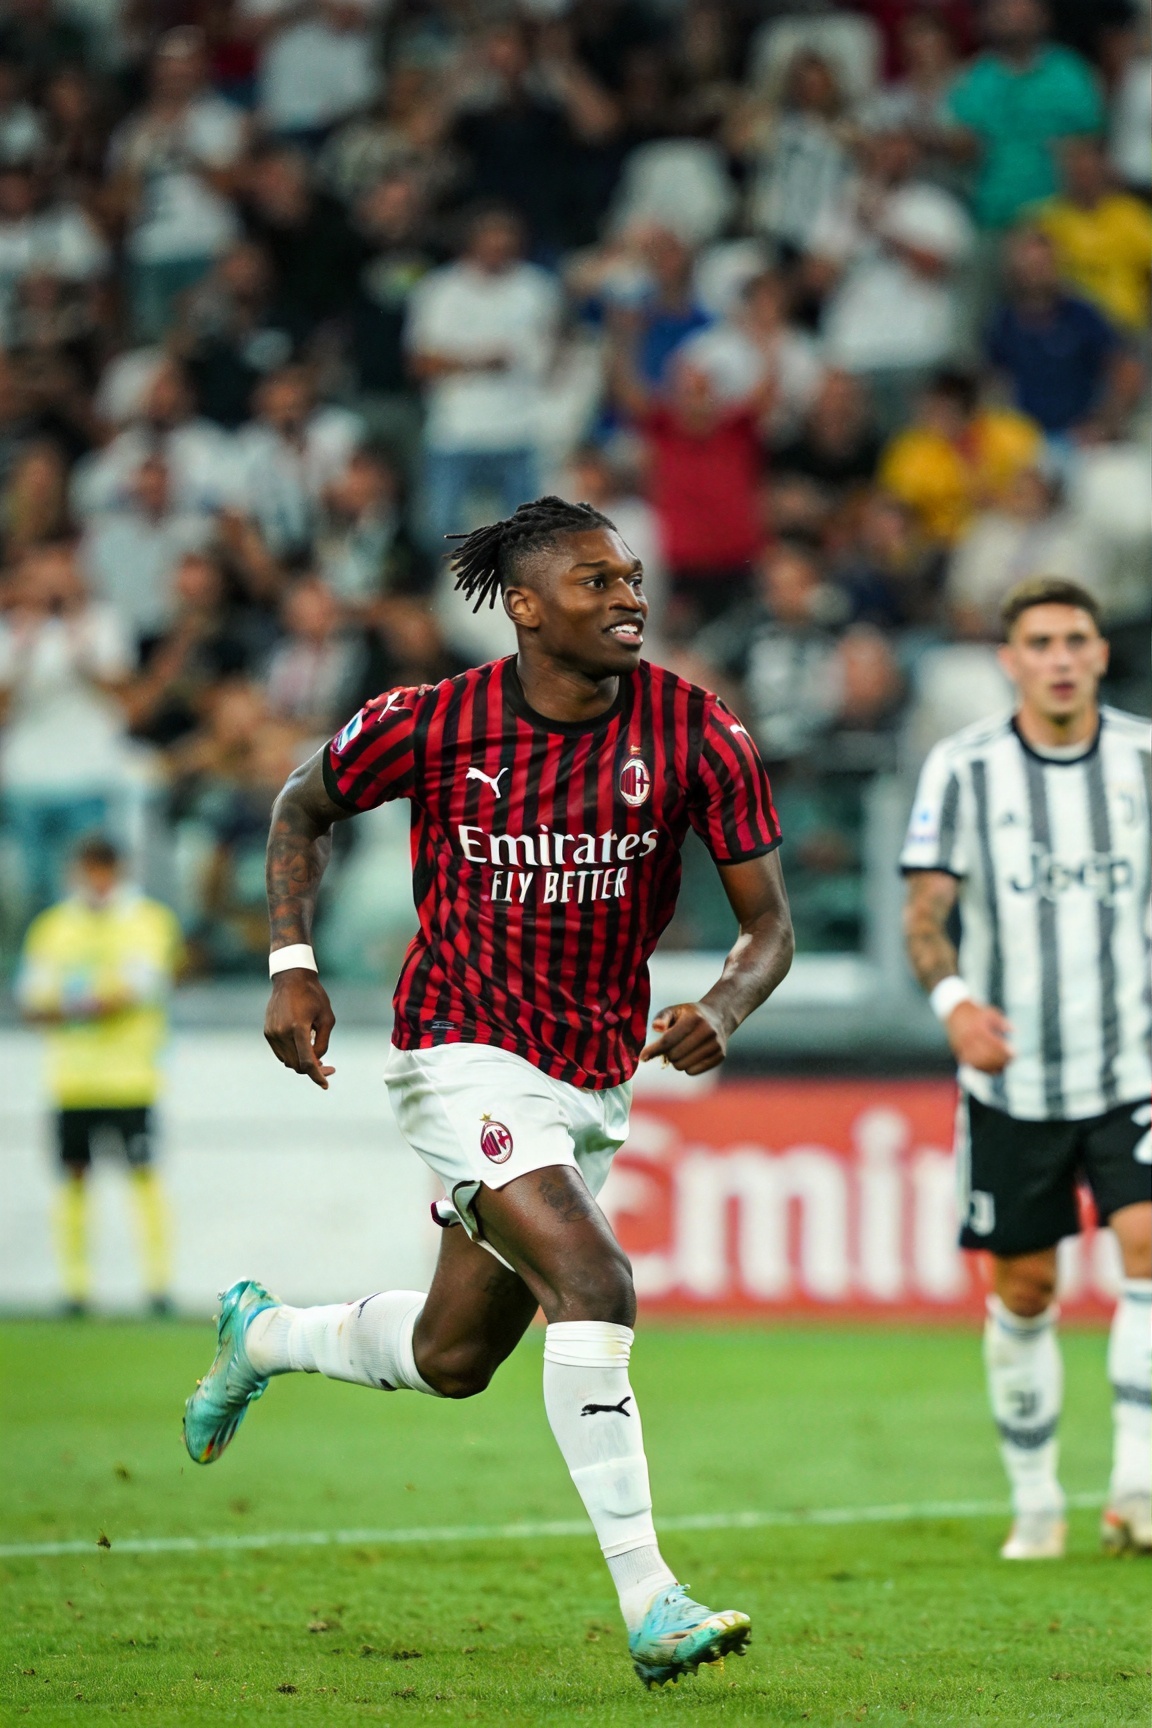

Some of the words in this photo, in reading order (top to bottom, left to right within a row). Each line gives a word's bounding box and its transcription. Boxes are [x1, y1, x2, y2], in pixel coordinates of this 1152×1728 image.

[457, 823, 660, 868] Emirates
[490, 870, 534, 903] FLY
[543, 866, 628, 904] BETTER
